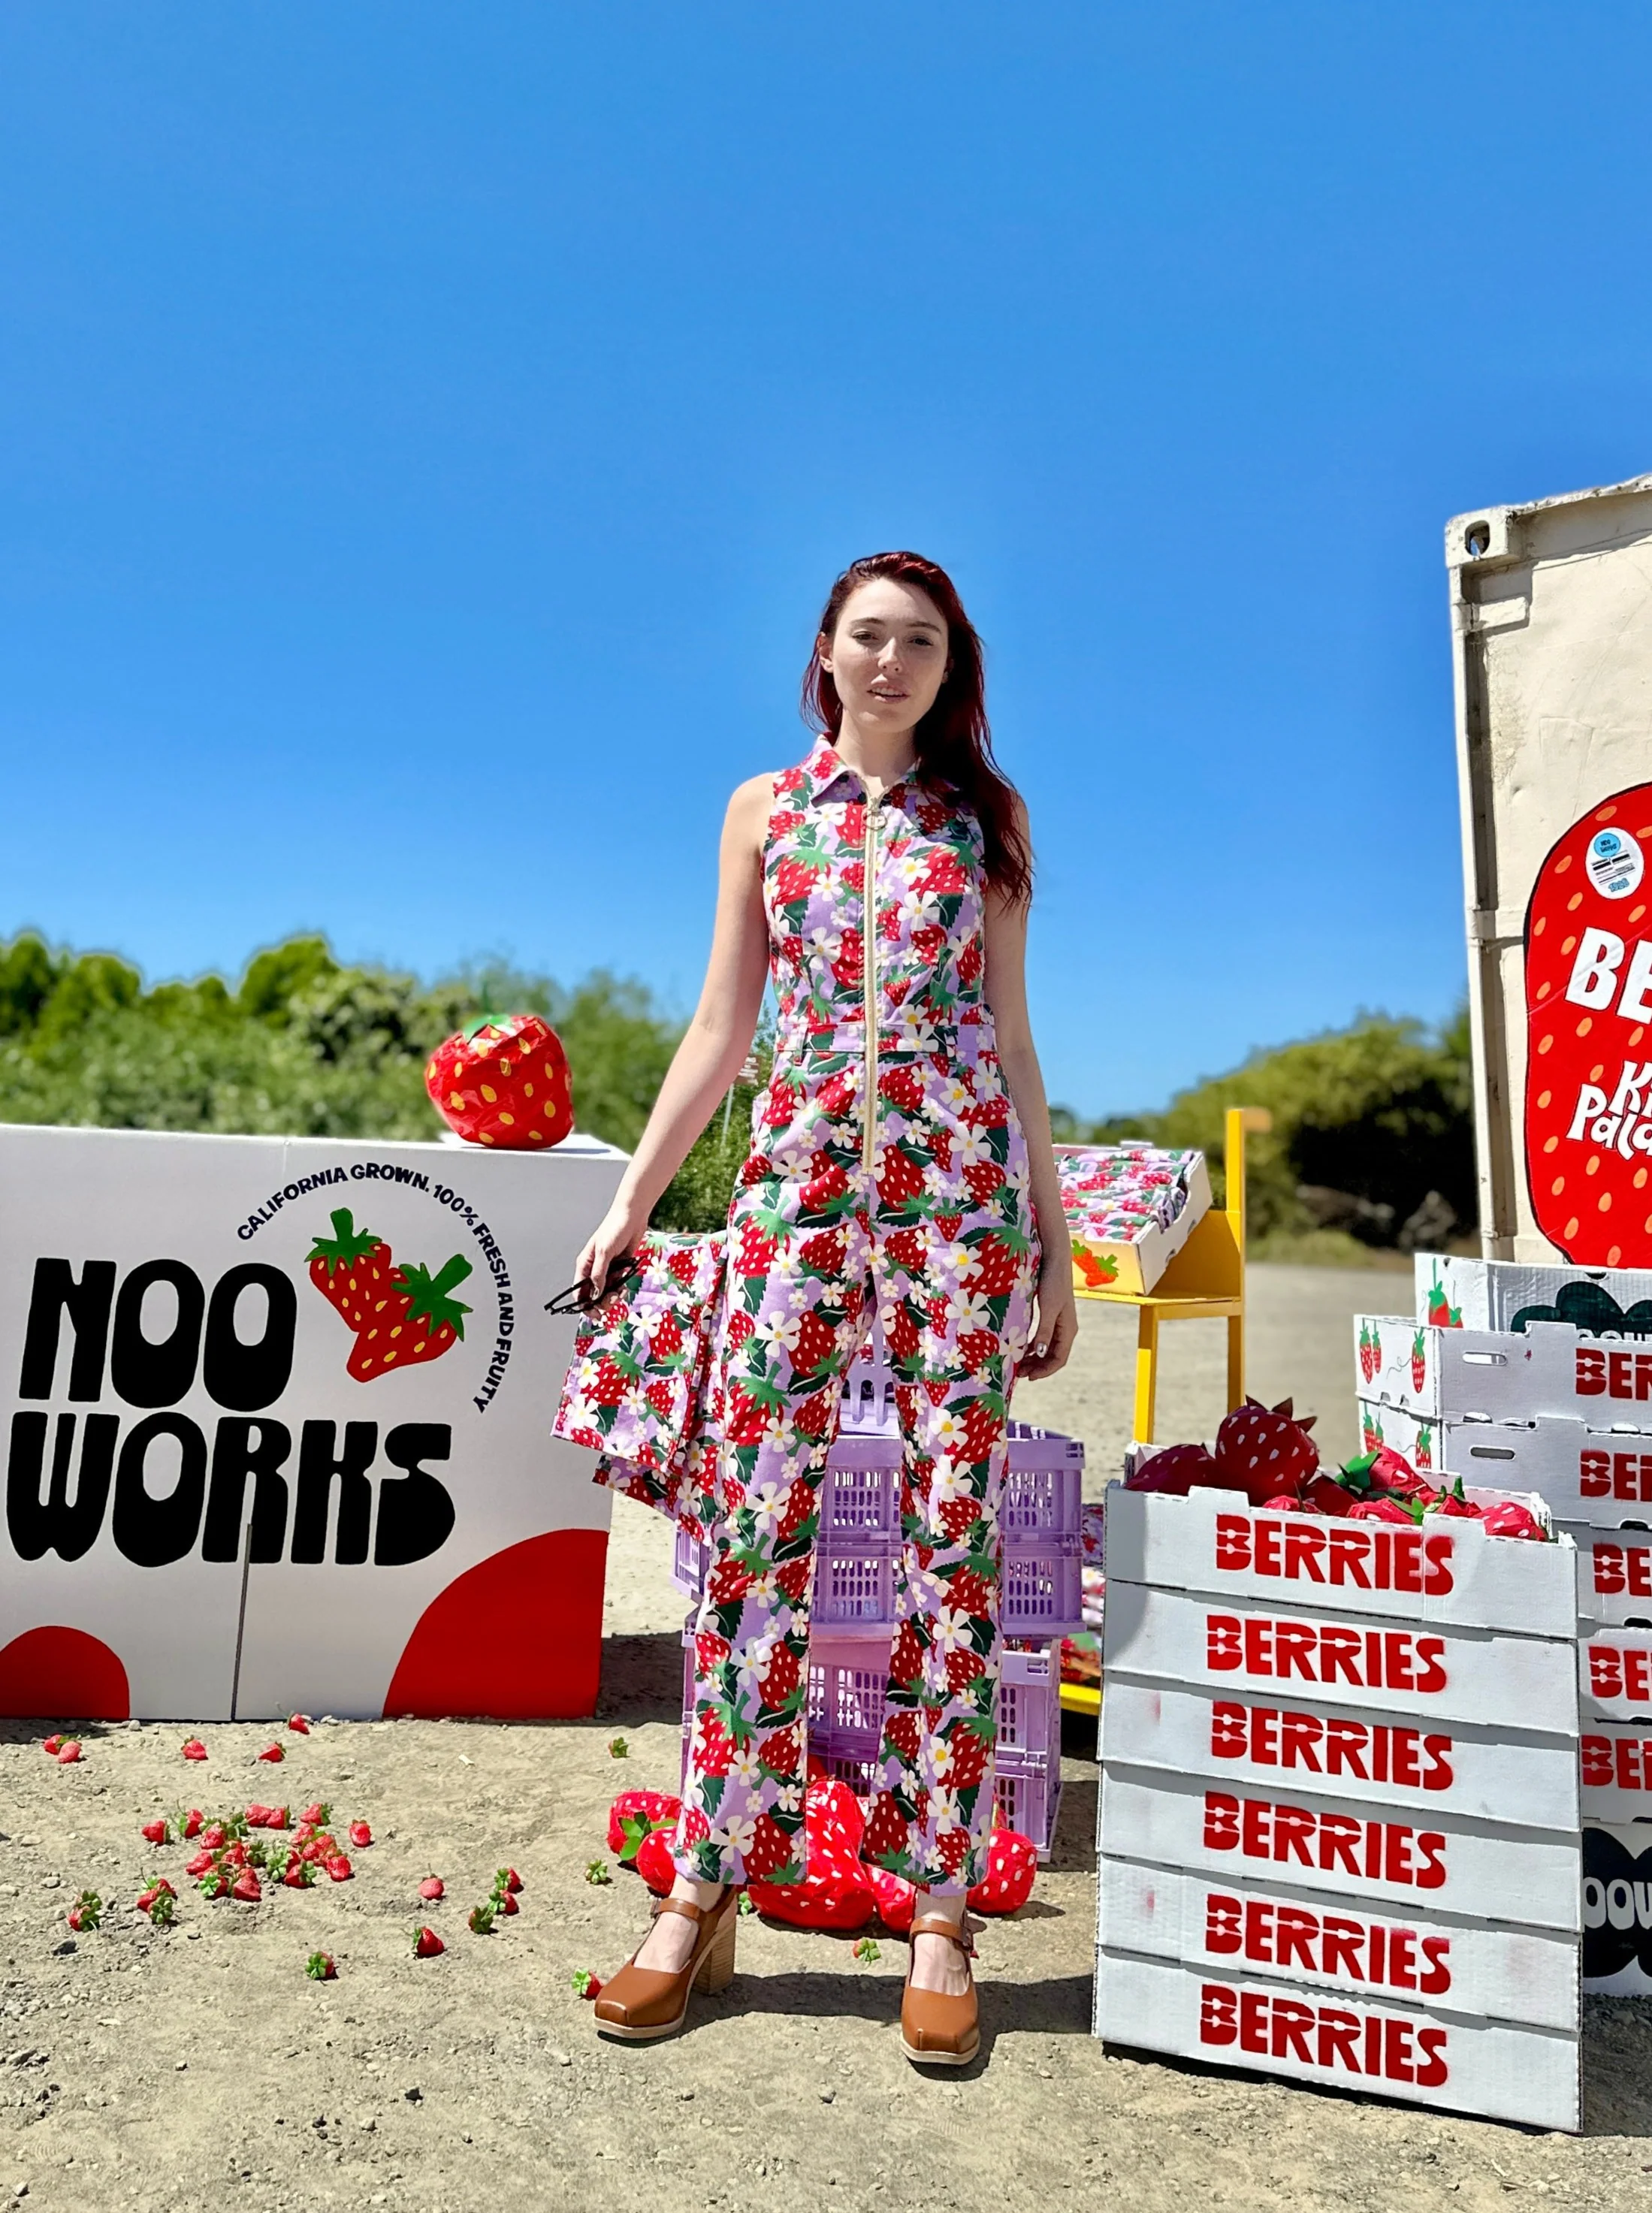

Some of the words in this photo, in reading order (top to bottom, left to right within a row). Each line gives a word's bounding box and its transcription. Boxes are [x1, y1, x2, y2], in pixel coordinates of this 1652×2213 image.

[237, 1167, 349, 1240] CALIFORNIA
[350, 1162, 430, 1192] GROWN.
[433, 1184, 479, 1227] 100%
[472, 1222, 511, 1288] FRESH
[19, 1257, 297, 1412] NOO
[497, 1292, 515, 1337] AND
[473, 1338, 513, 1414] FRUITY
[6, 1411, 456, 1568] WORKS
[1216, 1514, 1454, 1596] BERRIES
[1206, 1614, 1448, 1694] BERRIES
[1211, 1701, 1454, 1791] BERRIES
[1204, 1792, 1447, 1890] BERRIES
[1205, 1893, 1451, 1995] BERRIES
[1200, 1983, 1448, 2088] BERRIES
